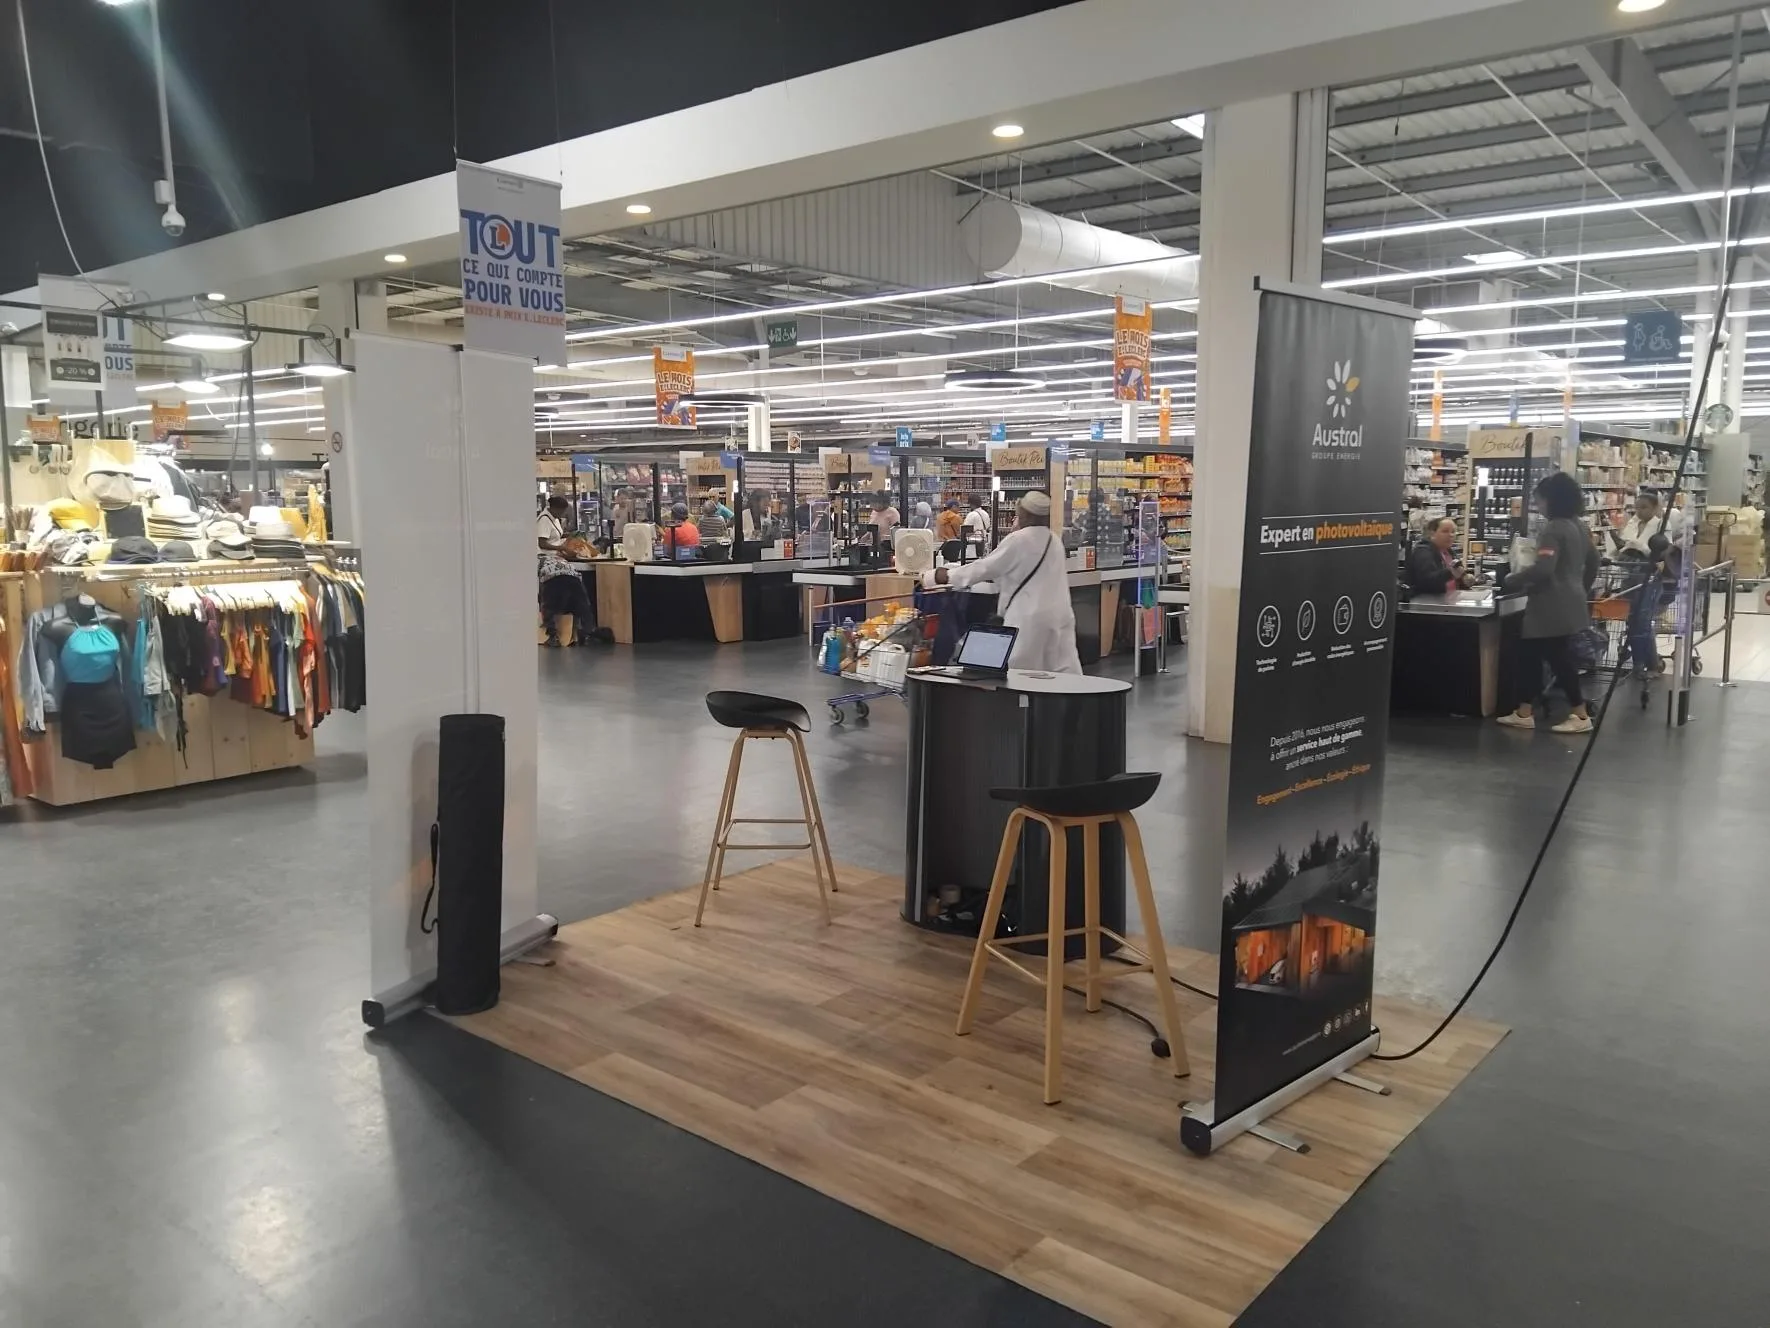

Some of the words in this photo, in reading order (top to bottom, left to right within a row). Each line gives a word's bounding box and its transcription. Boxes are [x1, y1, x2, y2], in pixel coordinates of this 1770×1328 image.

[460, 208, 560, 268] TOUT
[463, 258, 480, 275] CE
[487, 262, 510, 280] QUI
[517, 267, 563, 288] COMPTE
[464, 278, 512, 306] POUR
[519, 287, 564, 313] VOUS
[1116, 330, 1128, 345] LE
[104, 356, 133, 371] OUS
[656, 371, 669, 384] LE
[1312, 423, 1363, 447] Austral
[1260, 525, 1301, 548] Expert
[1302, 527, 1314, 540] en
[1315, 519, 1394, 545] photovoltaïque
[1306, 727, 1321, 736] nous
[1321, 723, 1335, 732] nous
[1296, 740, 1318, 753] service
[1318, 737, 1332, 747] haut
[1332, 733, 1341, 742] de
